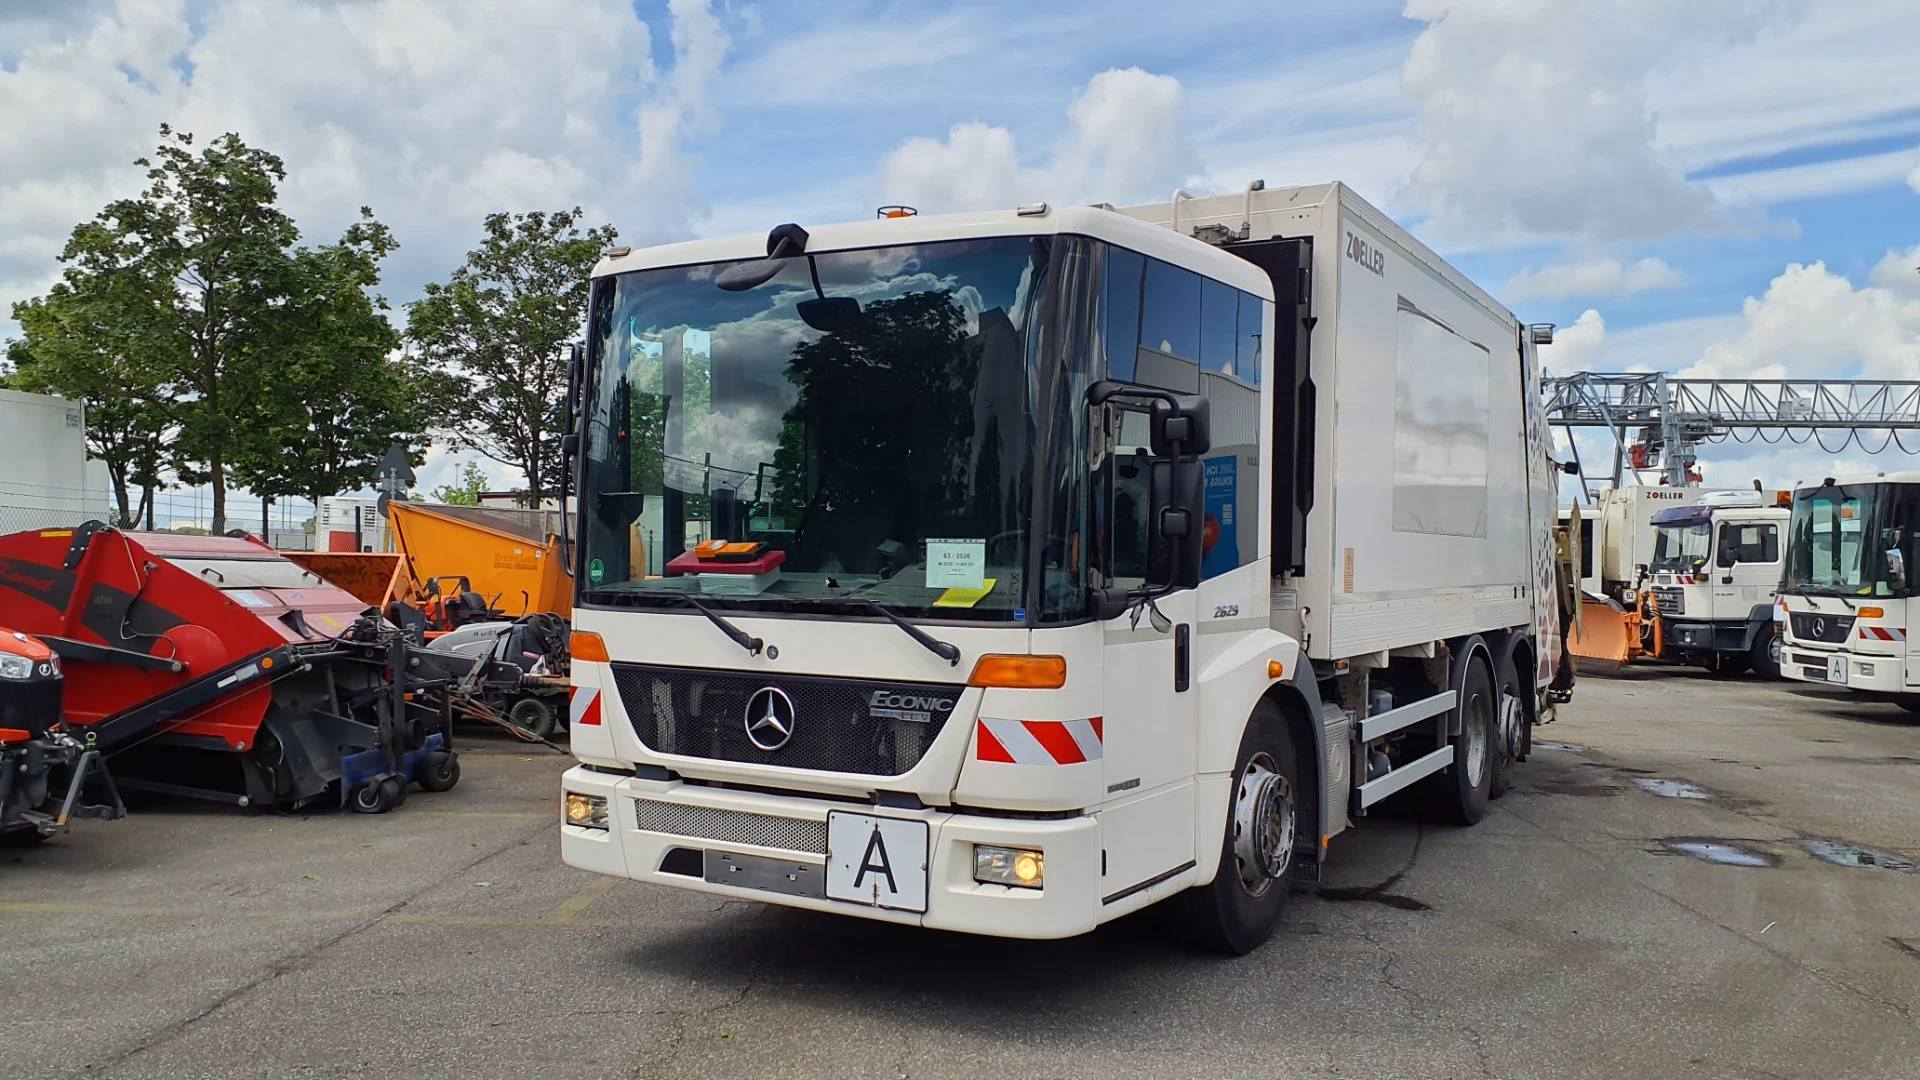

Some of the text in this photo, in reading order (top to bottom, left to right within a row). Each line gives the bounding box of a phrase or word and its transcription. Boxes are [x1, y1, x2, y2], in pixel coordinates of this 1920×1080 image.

[1346, 231, 1384, 278] ZOELLER
[1646, 491, 1683, 500] ZOELLER
[1833, 659, 1842, 679] A
[853, 829, 898, 894] A
